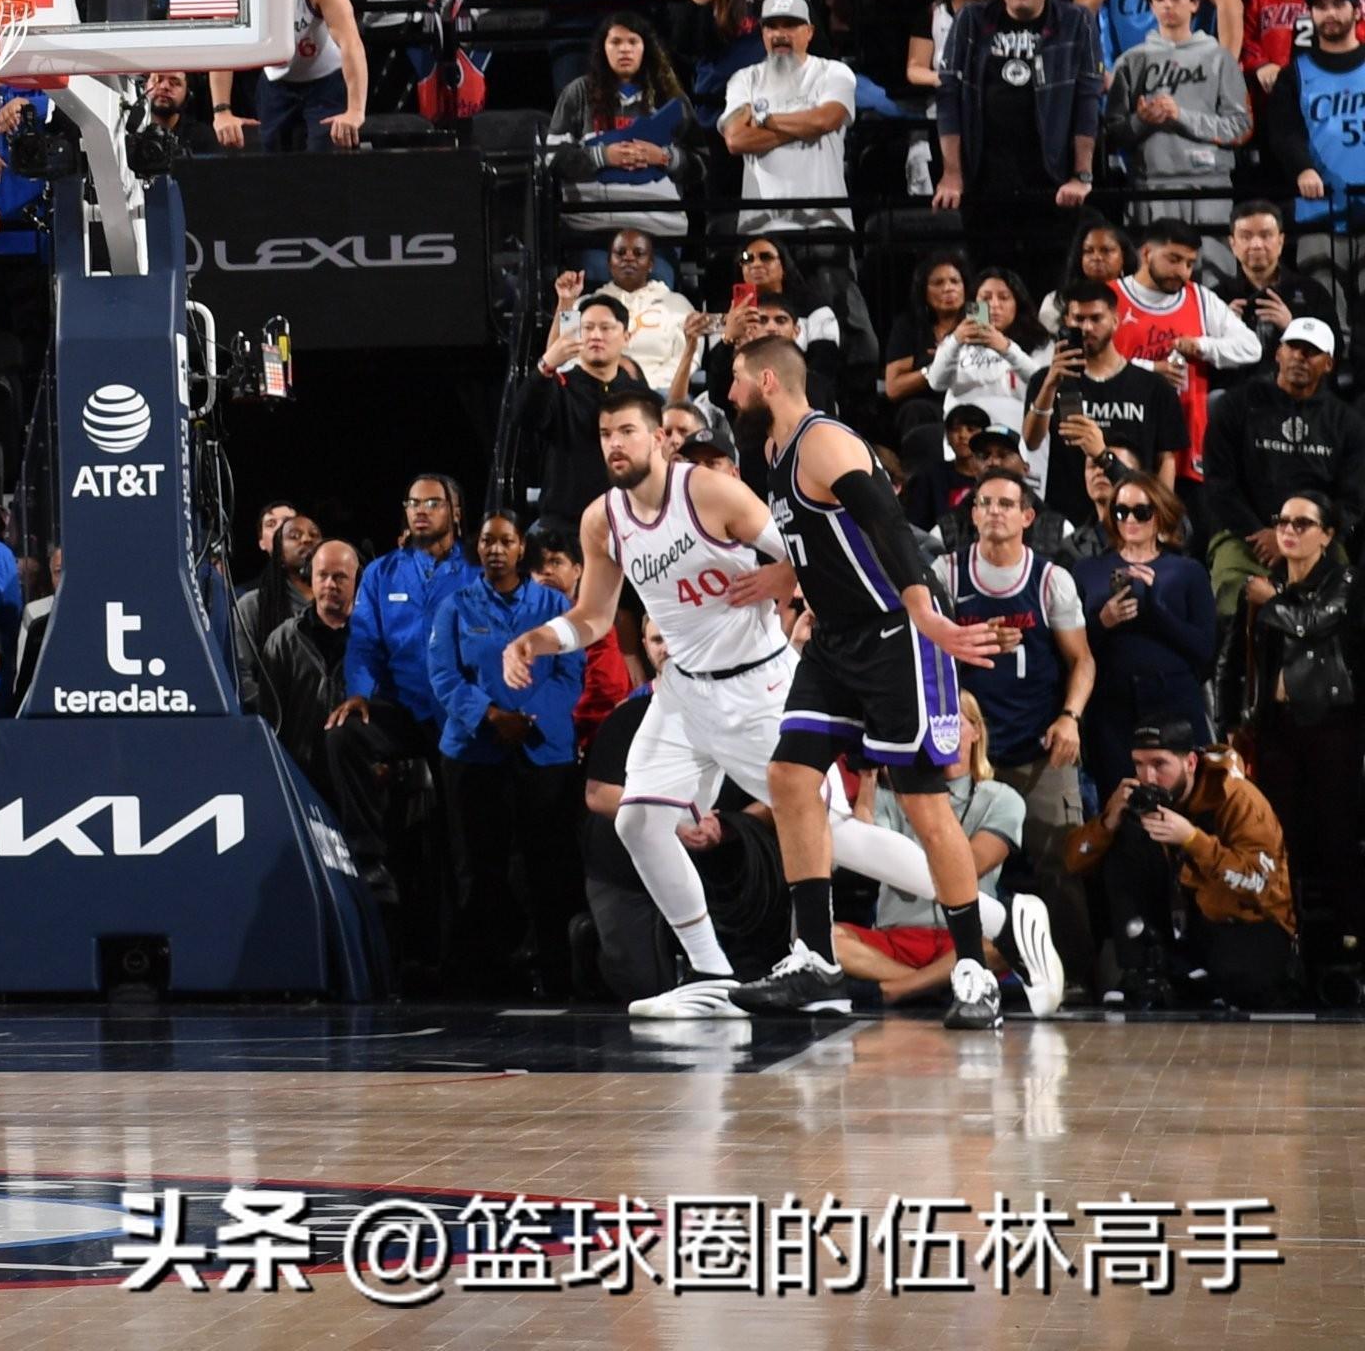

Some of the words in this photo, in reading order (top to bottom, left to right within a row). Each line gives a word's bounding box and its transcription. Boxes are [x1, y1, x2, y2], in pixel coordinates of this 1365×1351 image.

[1293, 18, 1313, 48] 2
[1143, 60, 1206, 97] Clips
[1309, 90, 1365, 124] Clip
[214, 233, 459, 272] LEXUS
[1082, 399, 1145, 424] LMAIN
[72, 464, 165, 499] AT&T
[629, 530, 697, 588] Clippers
[676, 568, 730, 608] 40
[53, 684, 197, 715] teradata.
